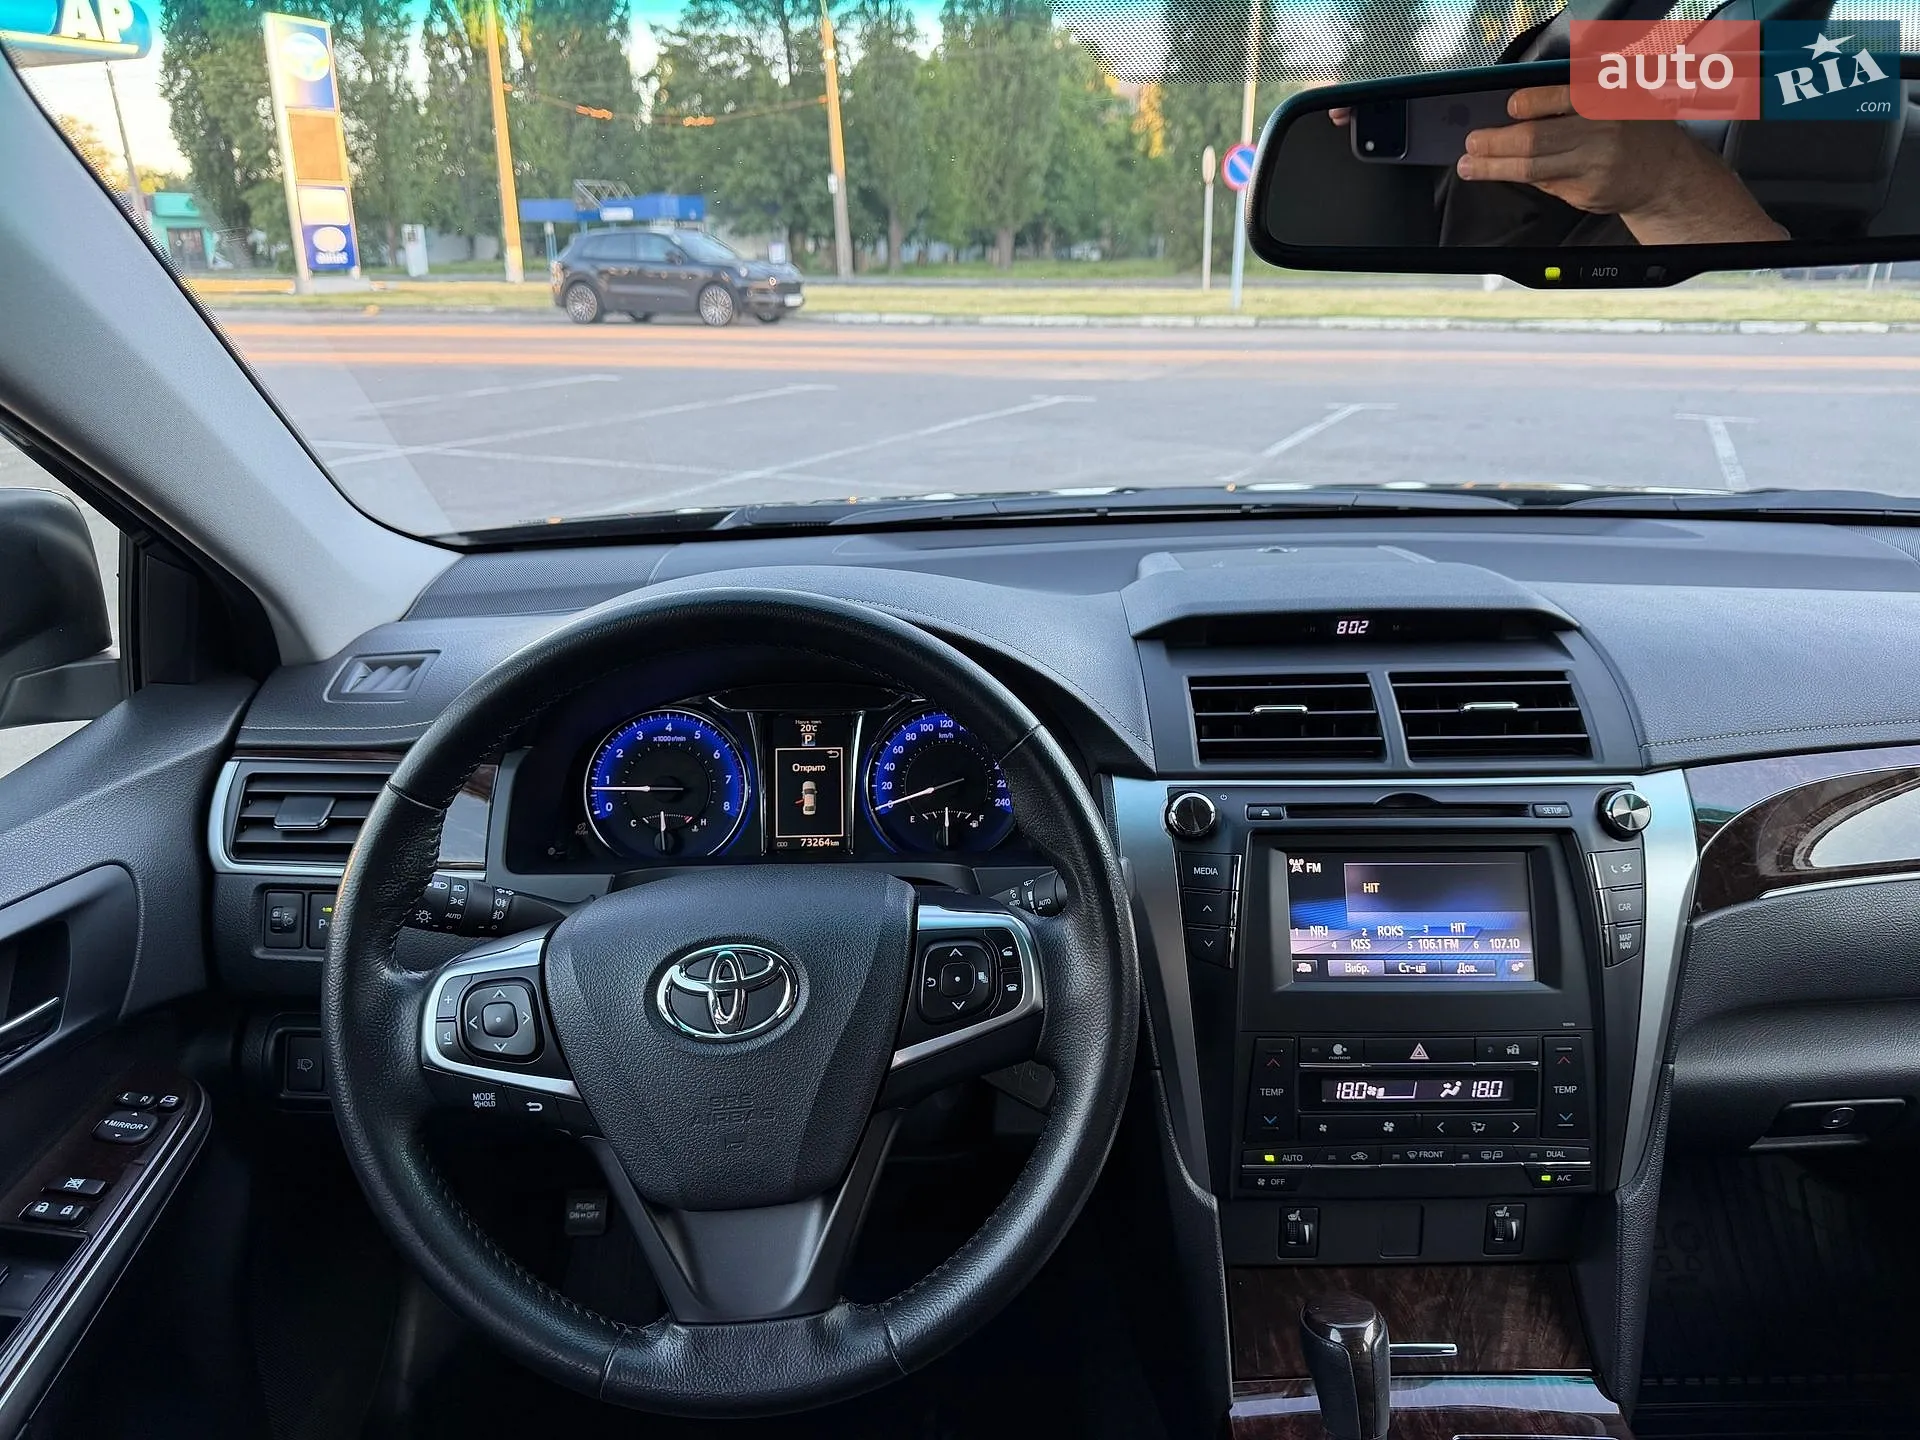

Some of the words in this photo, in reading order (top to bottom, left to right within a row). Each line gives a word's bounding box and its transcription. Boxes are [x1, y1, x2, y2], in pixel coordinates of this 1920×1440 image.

[1592, 267, 1618, 277] AUTO
[665, 723, 672, 731] 4
[920, 723, 934, 732] 100
[940, 720, 953, 728] 120
[636, 731, 643, 740] 3
[694, 731, 701, 739] 5
[906, 733, 917, 741] 80
[804, 734, 812, 745] P
[616, 749, 624, 758] 2
[893, 746, 904, 754] 60
[714, 751, 721, 759] 6
[792, 763, 826, 773] Открыто
[884, 763, 895, 771] 40
[606, 776, 610, 784] 1
[725, 775, 732, 784] 7
[882, 781, 892, 790] 20
[606, 803, 613, 811] 0
[723, 802, 730, 810] 8
[995, 799, 1010, 807] 240
[630, 819, 637, 827] C
[1193, 866, 1219, 875] MEDIA
[1306, 863, 1322, 873] FM
[1363, 882, 1380, 893] HIT
[1618, 903, 1632, 911] CAR
[445, 912, 462, 920] AUTO
[1310, 926, 1328, 936] NRJ
[1362, 928, 1368, 936] 2
[1377, 926, 1404, 936] ROKS
[1423, 925, 1429, 933] 3
[1450, 923, 1467, 933] HIT
[1331, 941, 1337, 950] 4
[1351, 939, 1371, 949] KISS
[1408, 941, 1413, 949] 5
[1418, 939, 1442, 950] 106.1
[1444, 939, 1459, 949] FM
[1474, 941, 1479, 949] 6
[1490, 939, 1520, 949] 107.10
[1620, 942, 1632, 950] NAV
[1345, 963, 1370, 974] Вибр.
[1457, 963, 1478, 974] Дов.
[1260, 1088, 1284, 1096] TEMP
[1553, 1085, 1578, 1094] TEMP
[472, 1092, 496, 1100] MODE
[108, 1119, 144, 1130] MIRROR
[1282, 1154, 1303, 1162] AUTO
